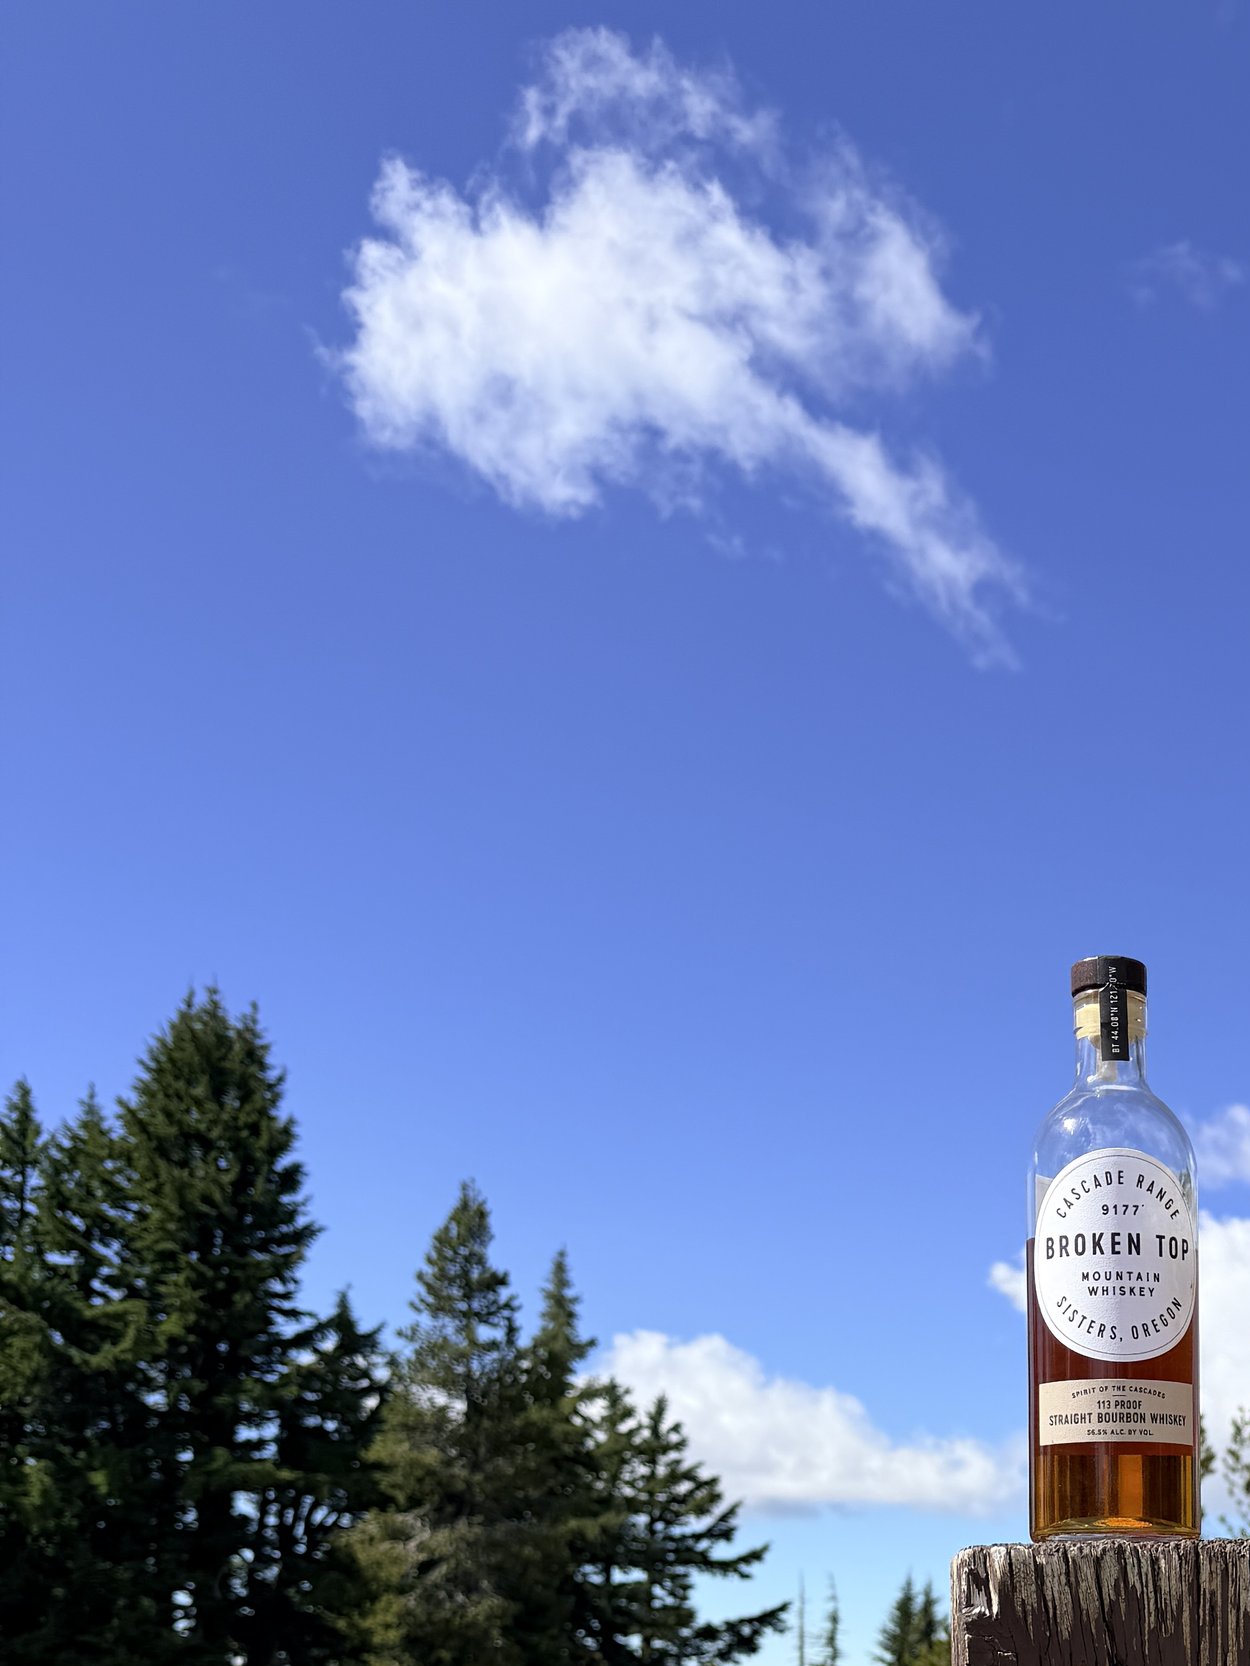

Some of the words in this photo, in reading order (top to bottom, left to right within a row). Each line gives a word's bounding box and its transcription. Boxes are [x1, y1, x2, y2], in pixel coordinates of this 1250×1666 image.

[1111, 1043, 1120, 1053] BT
[1056, 1170, 1124, 1218] CASCADE
[1136, 1174, 1180, 1220] RANGE
[1046, 1232, 1141, 1260] BROKEN
[1155, 1234, 1189, 1261] TOP
[1081, 1271, 1160, 1283] MOUNTAIN
[1087, 1285, 1155, 1297] WHISKEY
[1056, 1296, 1123, 1342] SISTERS,
[1131, 1297, 1182, 1340] OREGON
[1071, 1387, 1096, 1399] SPIRIT
[1128, 1385, 1166, 1399] CASCADES
[1096, 1400, 1111, 1410] 113
[1114, 1400, 1142, 1410] PROOF
[1049, 1412, 1093, 1426] STRAIGHT
[1097, 1412, 1146, 1424] BOURBON
[1150, 1413, 1186, 1427] WHISKEY
[1087, 1428, 1108, 1436] 56.5%
